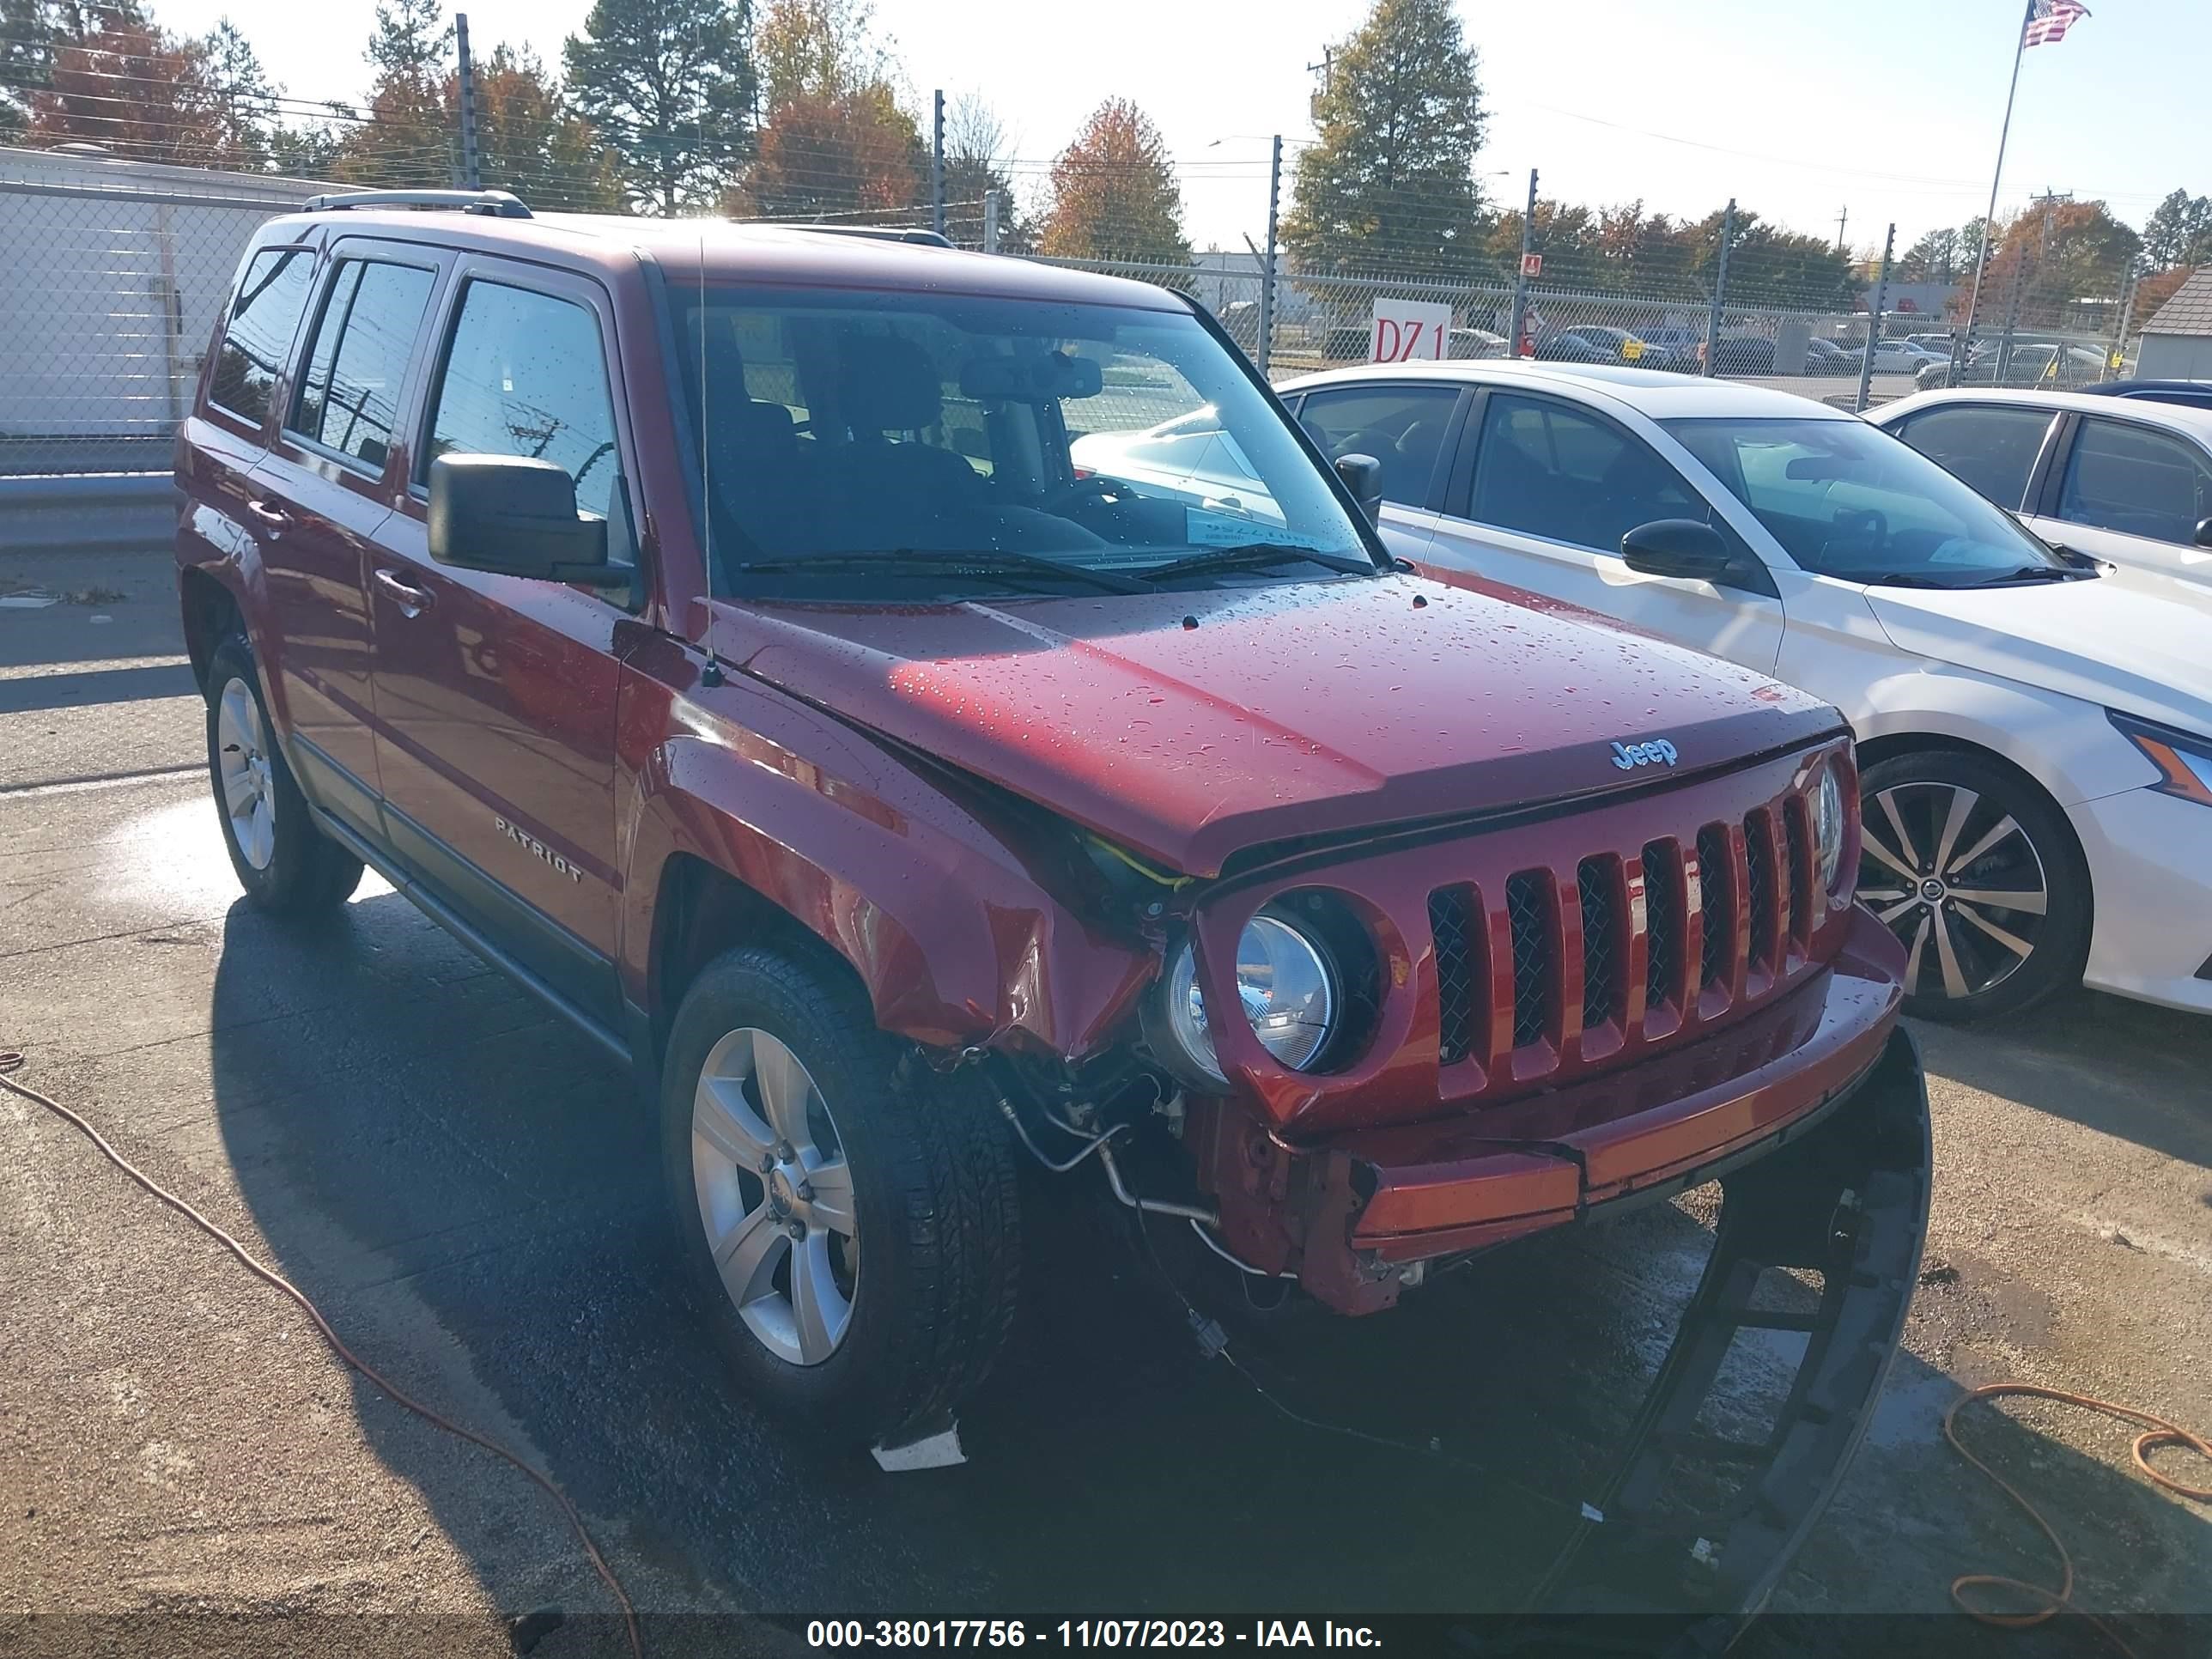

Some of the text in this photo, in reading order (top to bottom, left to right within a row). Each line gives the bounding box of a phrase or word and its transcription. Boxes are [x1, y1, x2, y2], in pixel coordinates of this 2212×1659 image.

[1373, 319, 1443, 363] DZ 1
[1609, 738, 1678, 770] Jeep
[495, 817, 583, 884] PATRIOT
